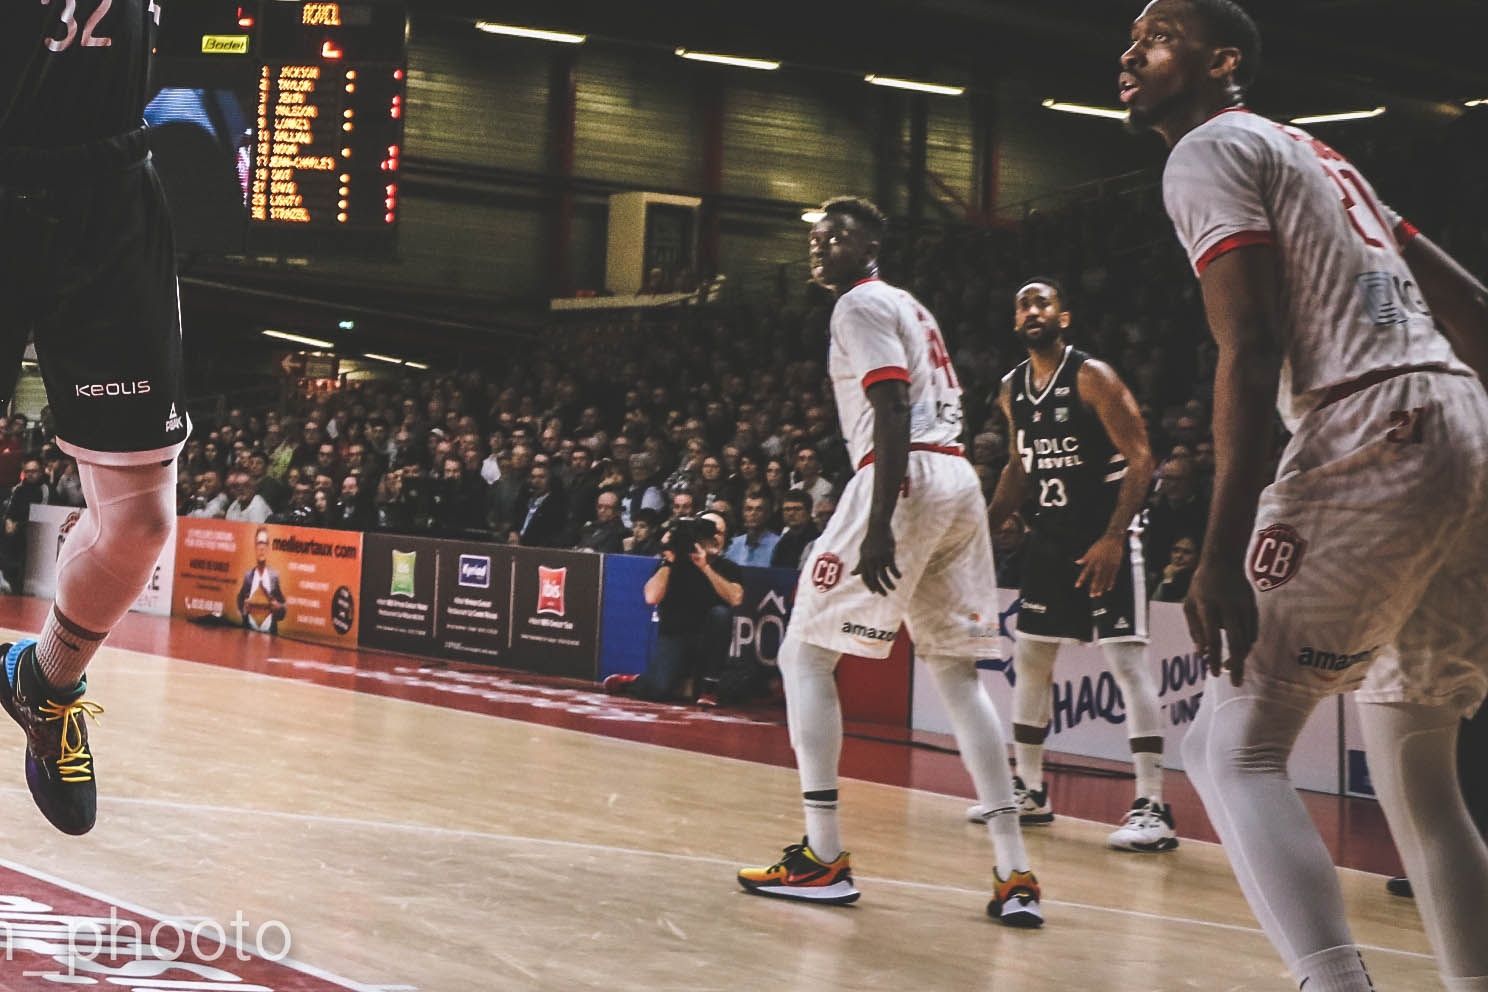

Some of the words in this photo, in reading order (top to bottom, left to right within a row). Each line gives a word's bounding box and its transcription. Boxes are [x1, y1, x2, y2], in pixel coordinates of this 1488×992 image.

[1039, 478, 1068, 507] 23
[812, 559, 839, 586] CB
[1254, 537, 1294, 578] CB
[1045, 670, 1128, 735] HAQ
